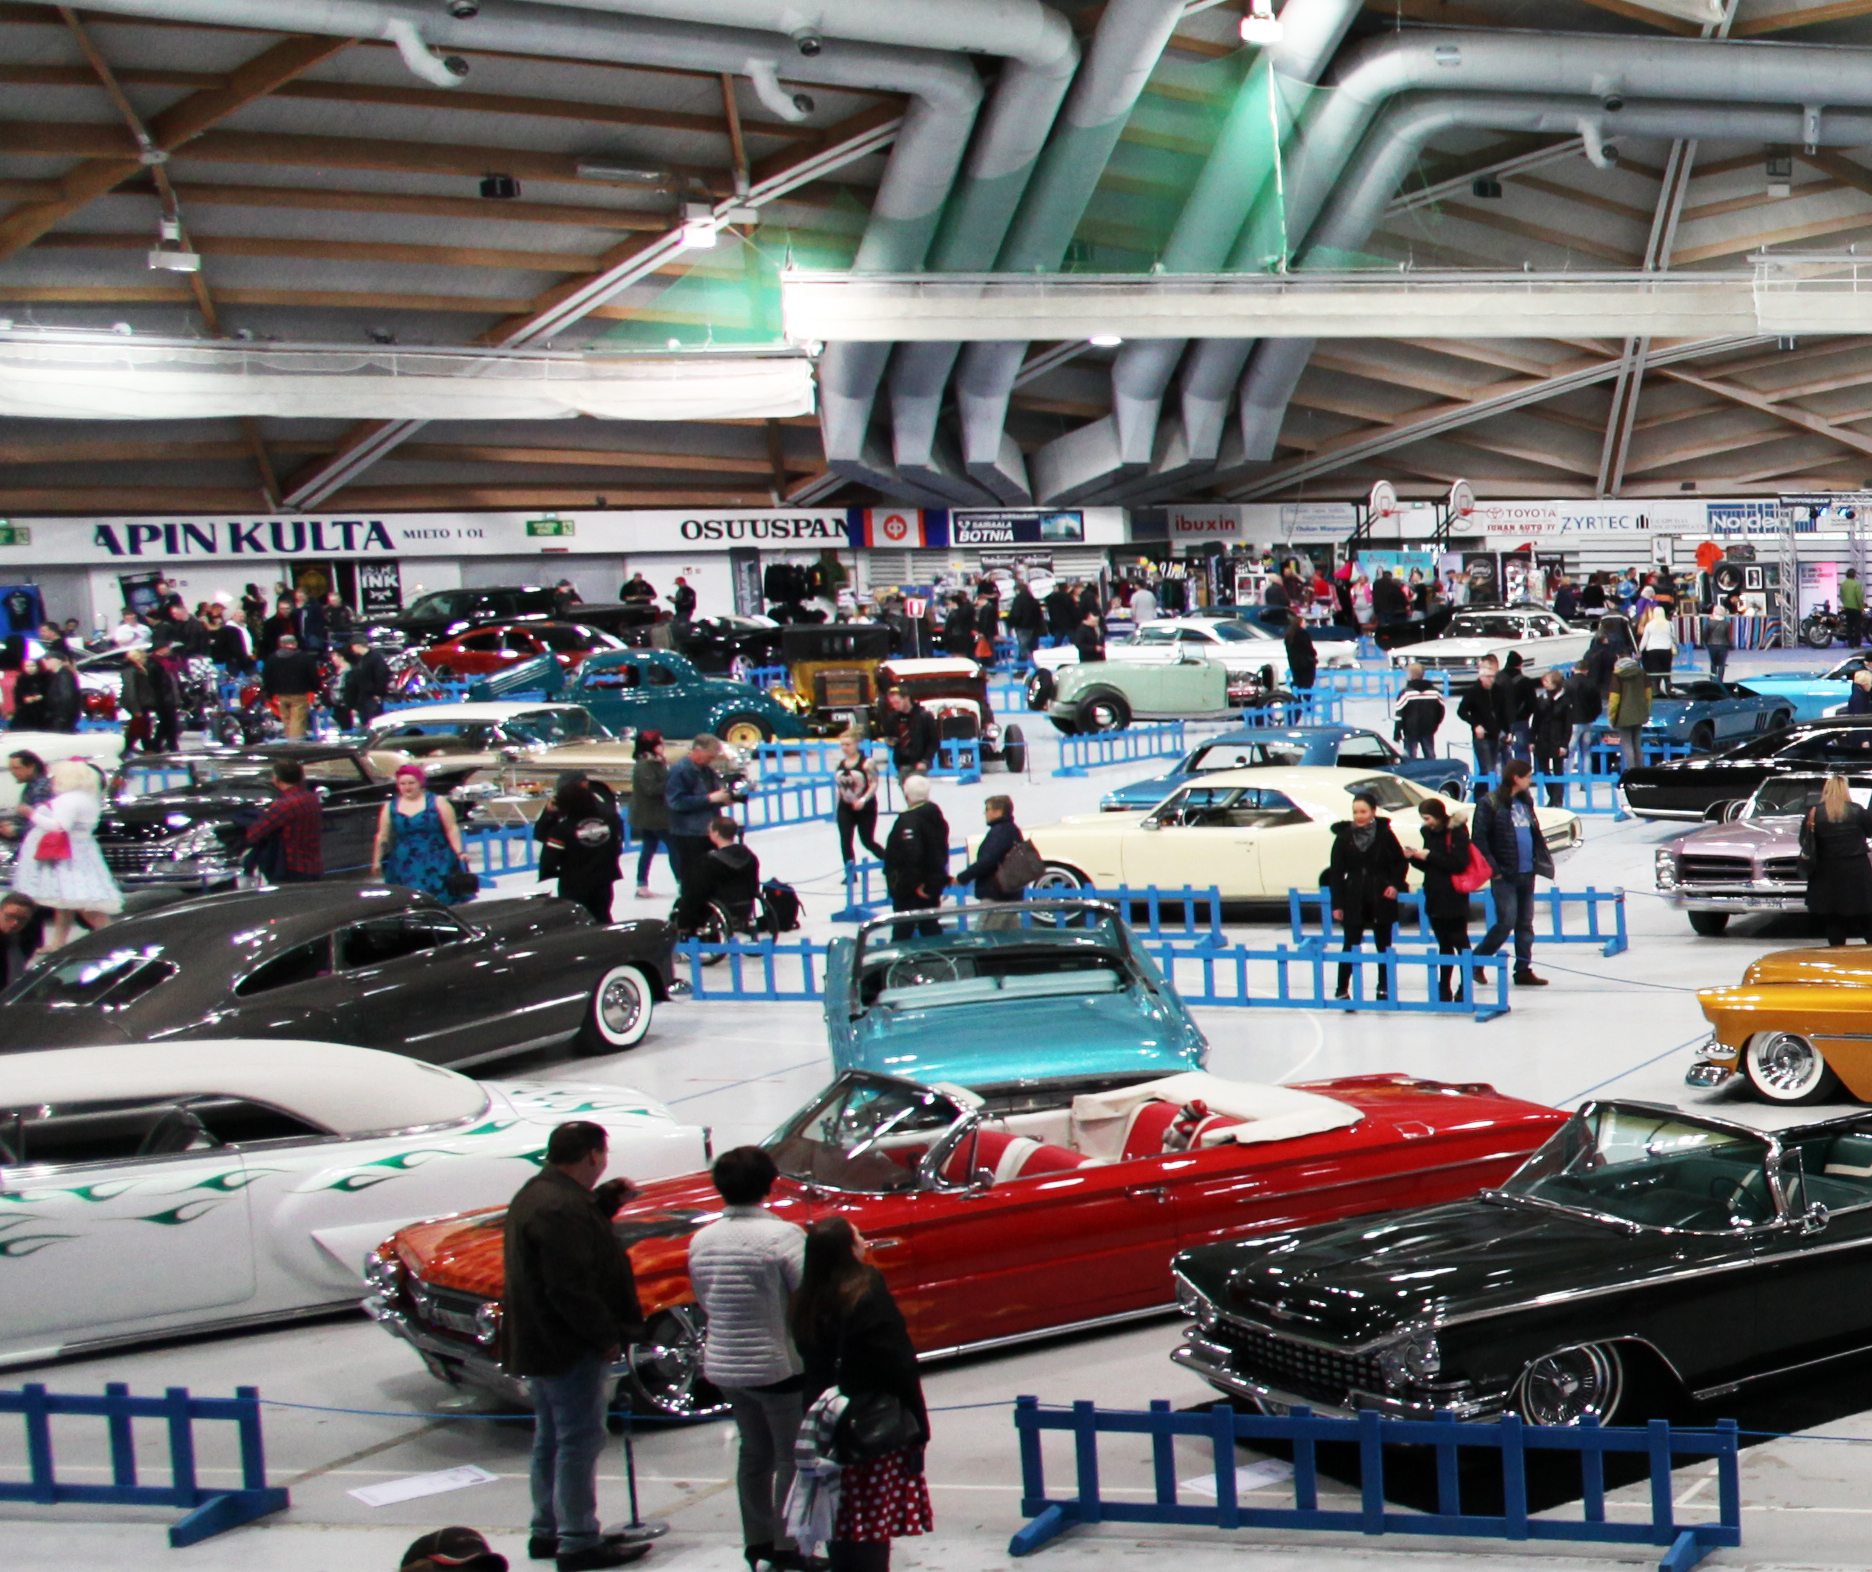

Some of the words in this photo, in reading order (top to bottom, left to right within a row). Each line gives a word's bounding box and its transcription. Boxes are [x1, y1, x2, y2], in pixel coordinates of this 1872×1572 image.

[1506, 508, 1557, 518] TOYOTA
[1561, 515, 1630, 534] ZYRTEC
[227, 521, 397, 554] KULTA
[959, 529, 1014, 542] BOTNIA
[361, 573, 400, 589] INK
